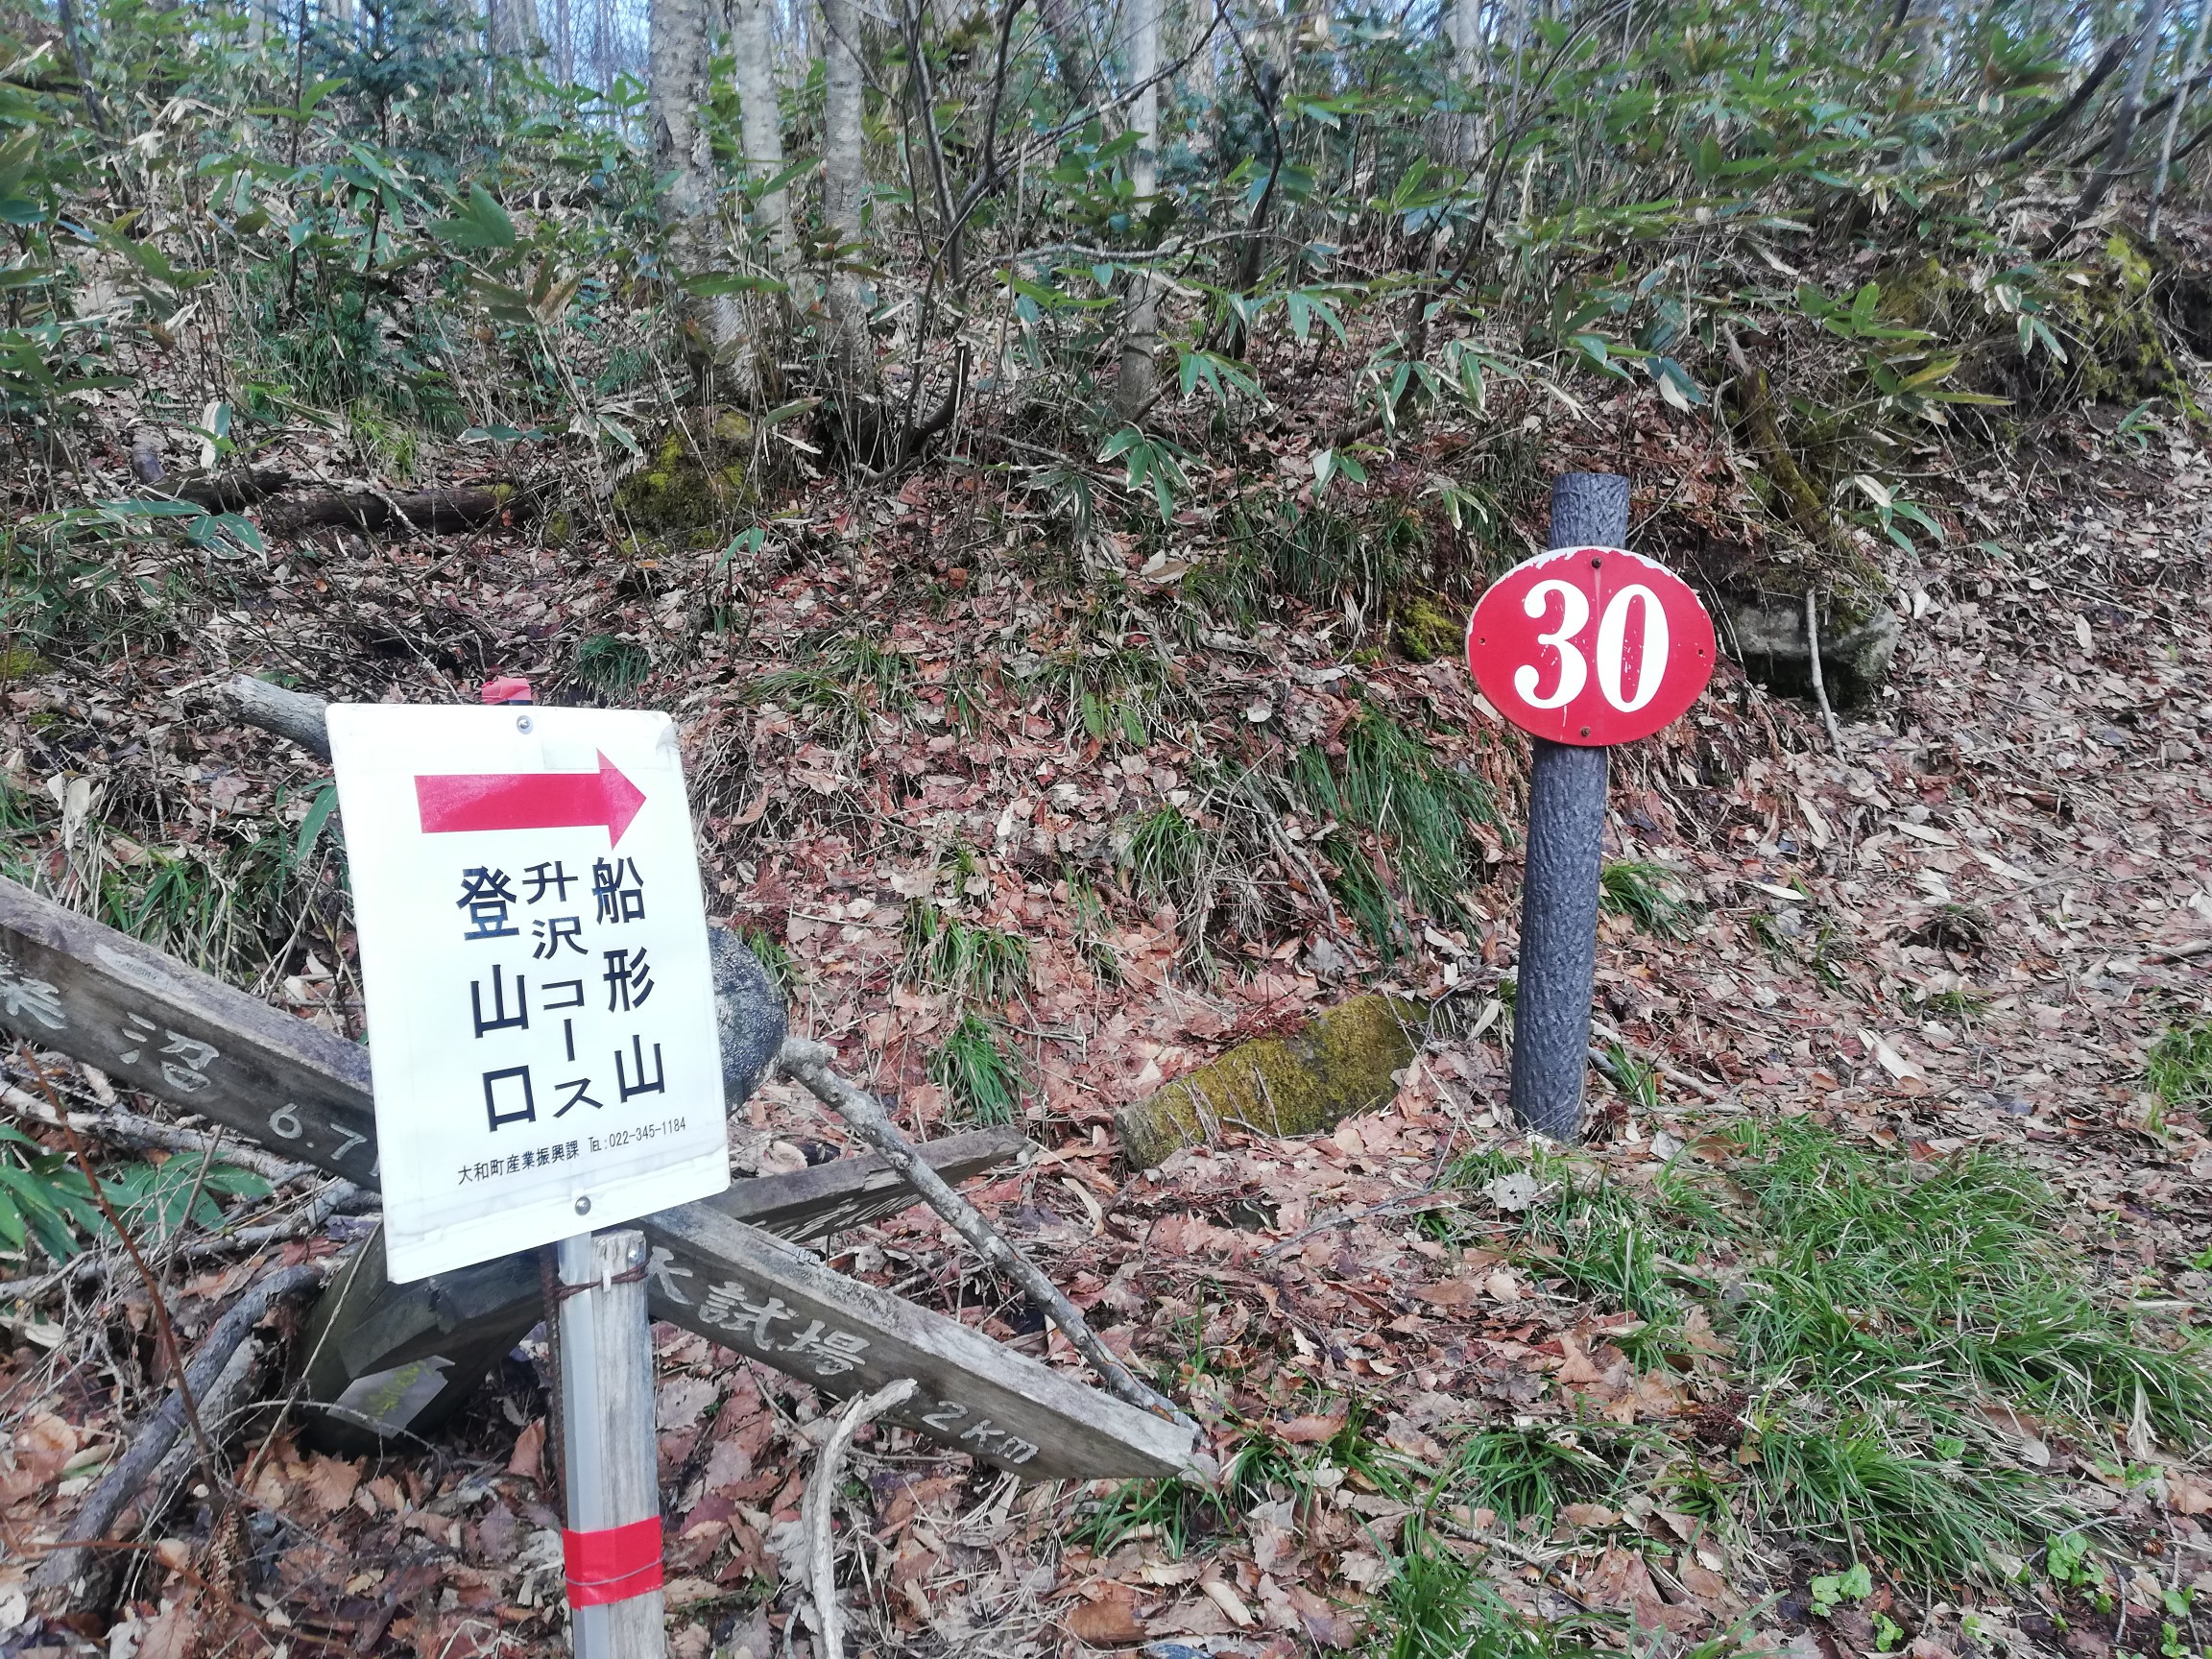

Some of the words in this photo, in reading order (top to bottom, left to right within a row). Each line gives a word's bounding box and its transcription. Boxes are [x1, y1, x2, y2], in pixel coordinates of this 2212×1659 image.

[1514, 579, 1669, 712] 30
[457, 866, 537, 1132] 登山口
[521, 860, 604, 1118] 升沢コース
[591, 855, 666, 1104] 船形山
[268, 1102, 382, 1177] 6.7
[458, 1140, 579, 1186] 大和町産業振興課
